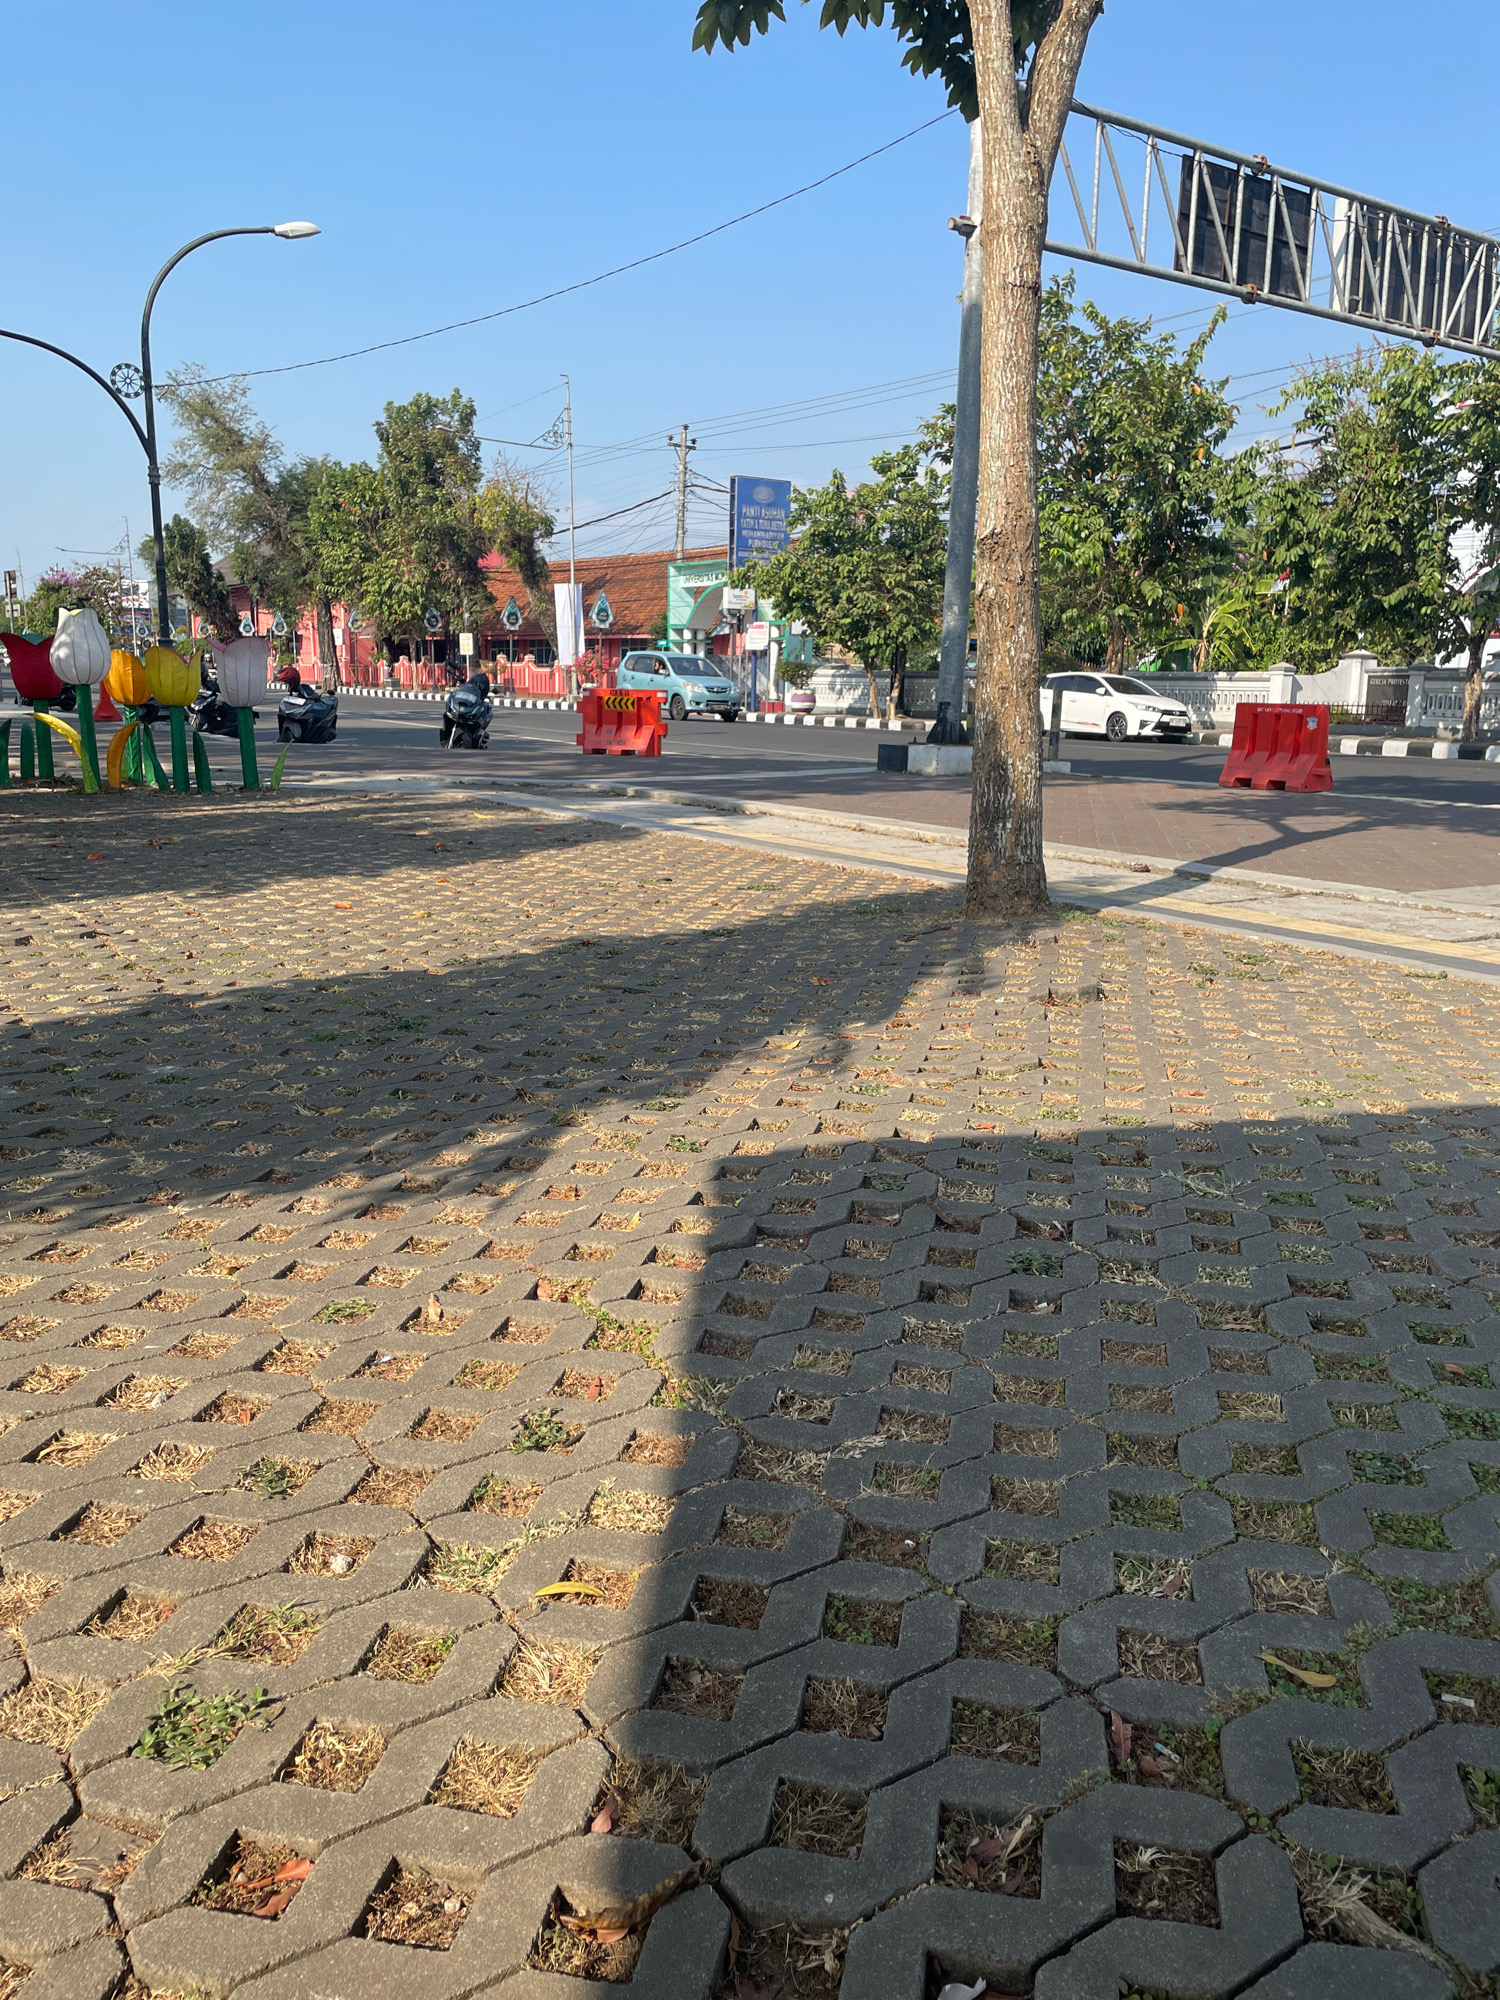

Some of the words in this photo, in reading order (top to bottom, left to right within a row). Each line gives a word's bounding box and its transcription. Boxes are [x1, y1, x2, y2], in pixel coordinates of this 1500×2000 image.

[742, 505, 760, 518] PANTI
[761, 507, 785, 520] ASUHAN
[683, 572, 713, 584] UNIVERSITAS
